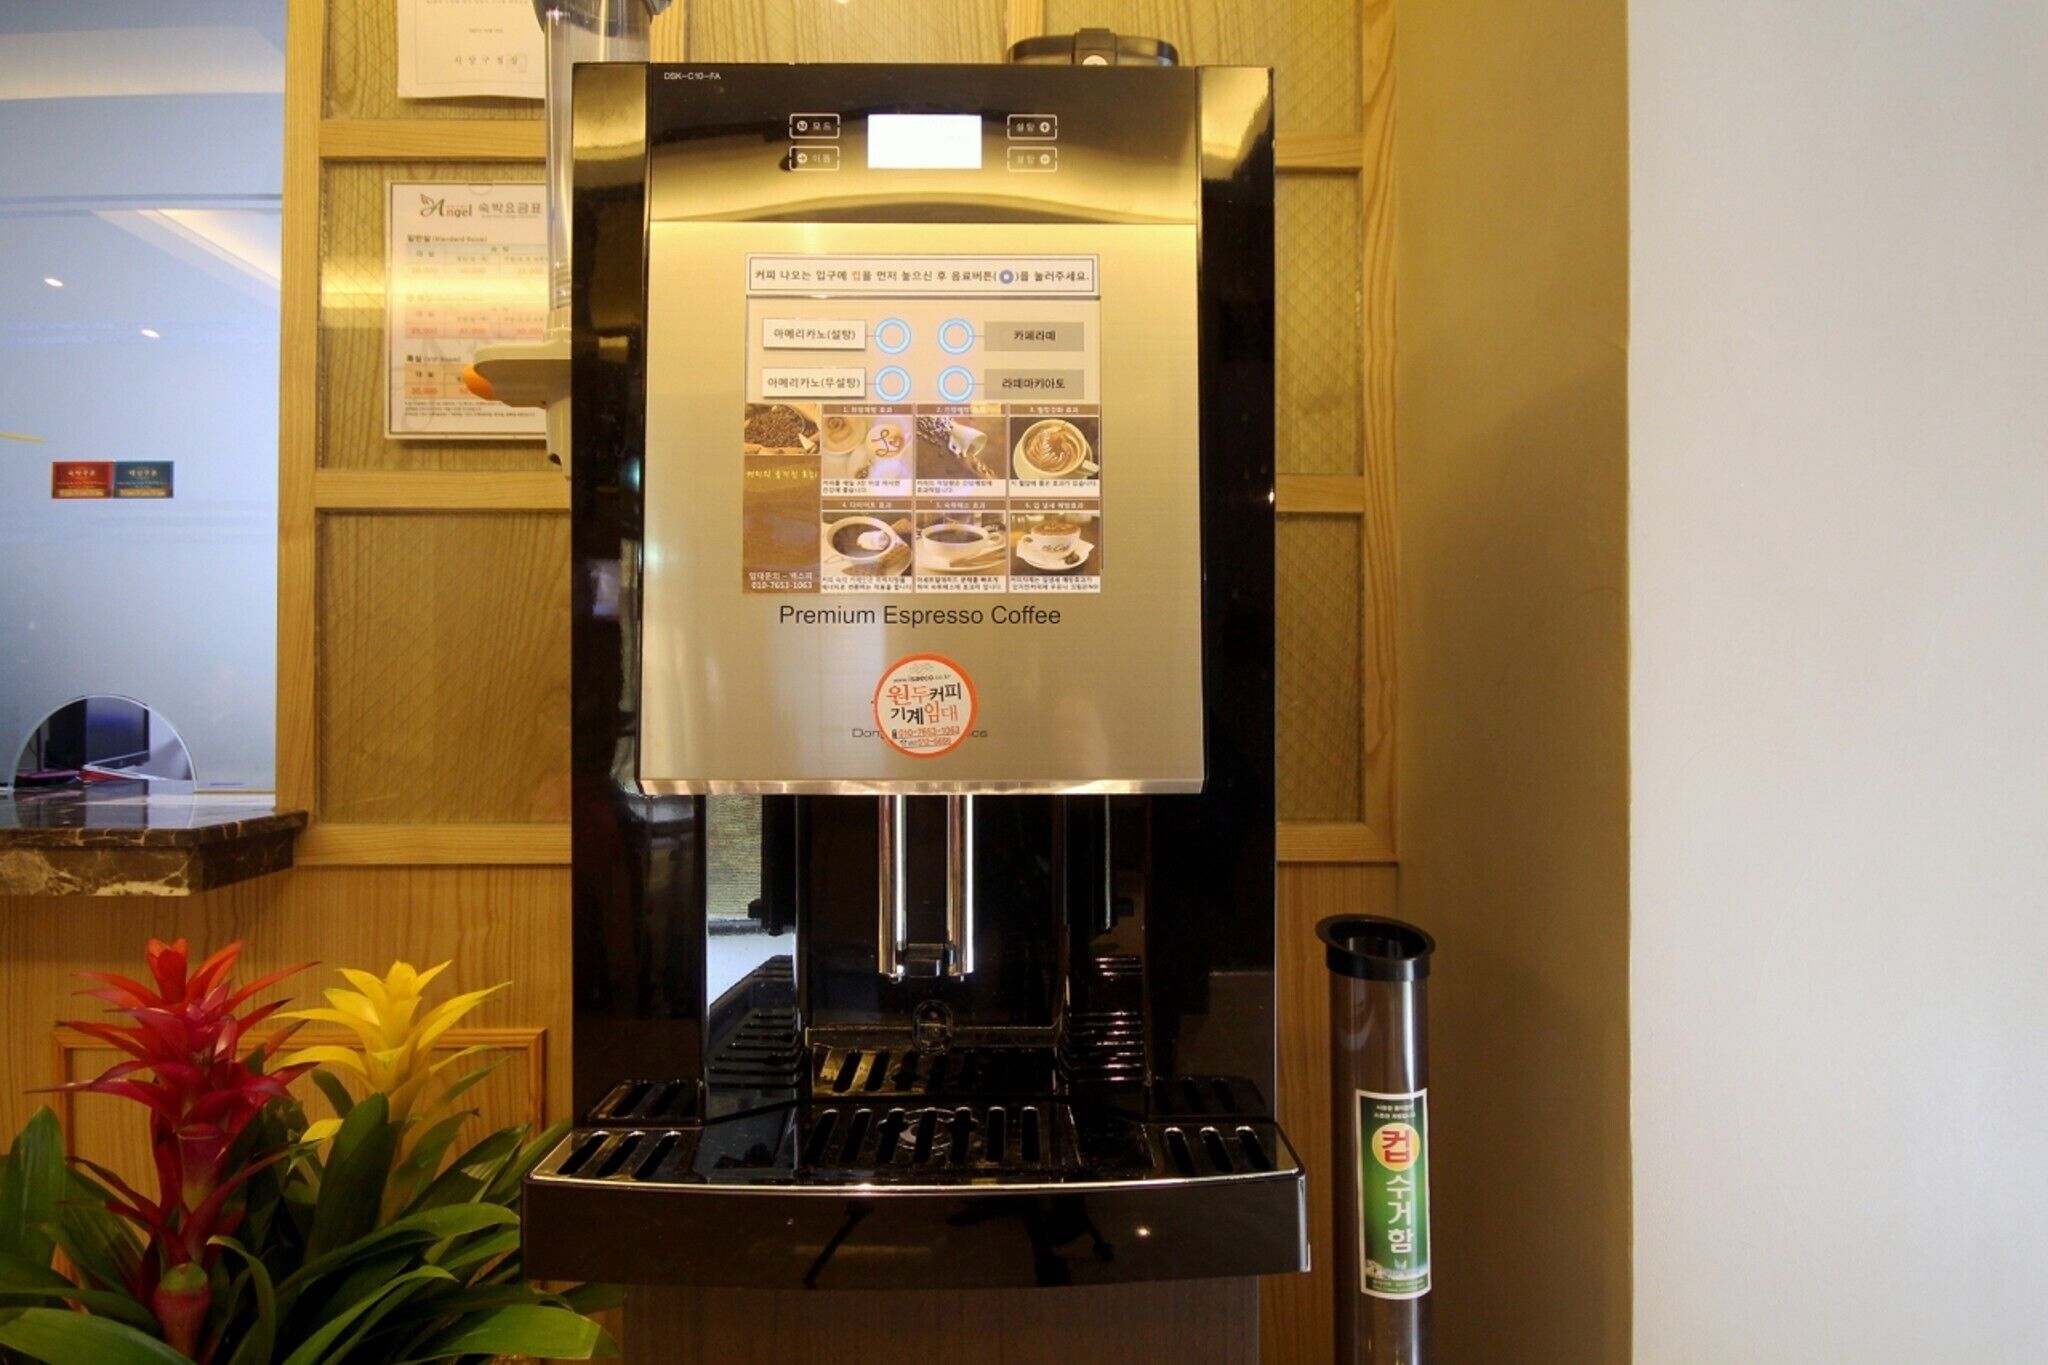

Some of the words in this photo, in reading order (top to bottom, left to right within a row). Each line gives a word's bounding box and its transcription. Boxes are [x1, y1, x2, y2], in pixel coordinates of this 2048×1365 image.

[664, 72, 722, 80] DSK-C10-FA
[420, 195, 472, 218] Angel
[479, 202, 541, 214] 숙박요금표
[754, 270, 776, 281] 커피
[780, 270, 811, 281] 나오는
[816, 270, 847, 281] 입구에
[852, 270, 871, 281] 컵을
[877, 270, 897, 281] 먼저
[901, 270, 932, 281] 놓으신
[937, 270, 946, 281] 후
[774, 328, 856, 340] 아메리카노(설탕)
[768, 377, 861, 389] 아메리카노(무설탕)
[779, 605, 875, 625] Premium
[883, 605, 984, 629] Espresso
[990, 605, 1061, 625] Coffee
[886, 682, 962, 706] 원두커피
[890, 700, 959, 725] 기계임대
[1381, 1129, 1410, 1164] 컵
[1386, 1174, 1414, 1254] 수거함
